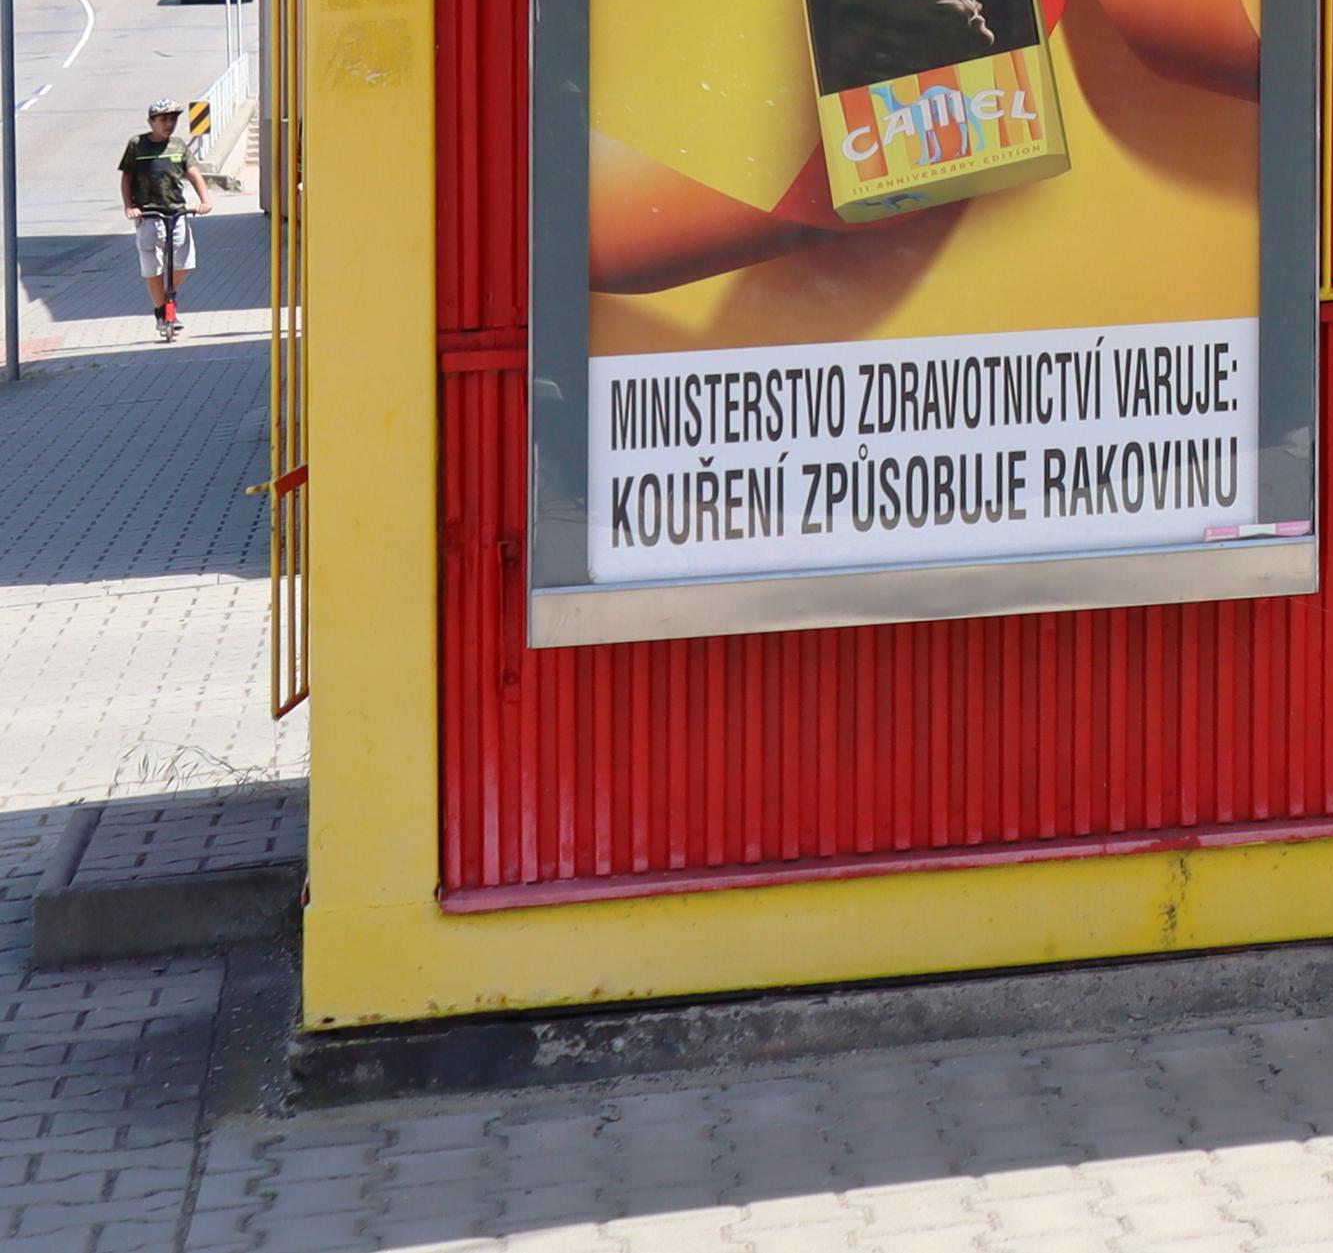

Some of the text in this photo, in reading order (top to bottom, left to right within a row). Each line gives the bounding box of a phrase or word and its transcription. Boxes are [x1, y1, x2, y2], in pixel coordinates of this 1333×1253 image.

[876, 143, 1043, 191] ANNIVERSARY EDITION
[609, 334, 1240, 452] MINISTERSTVO ZDRAVOTNICTVÍ VARUJE:
[610, 435, 1239, 549] KOUŘENÍ ZPŮSOBUJE RAKOVINU
